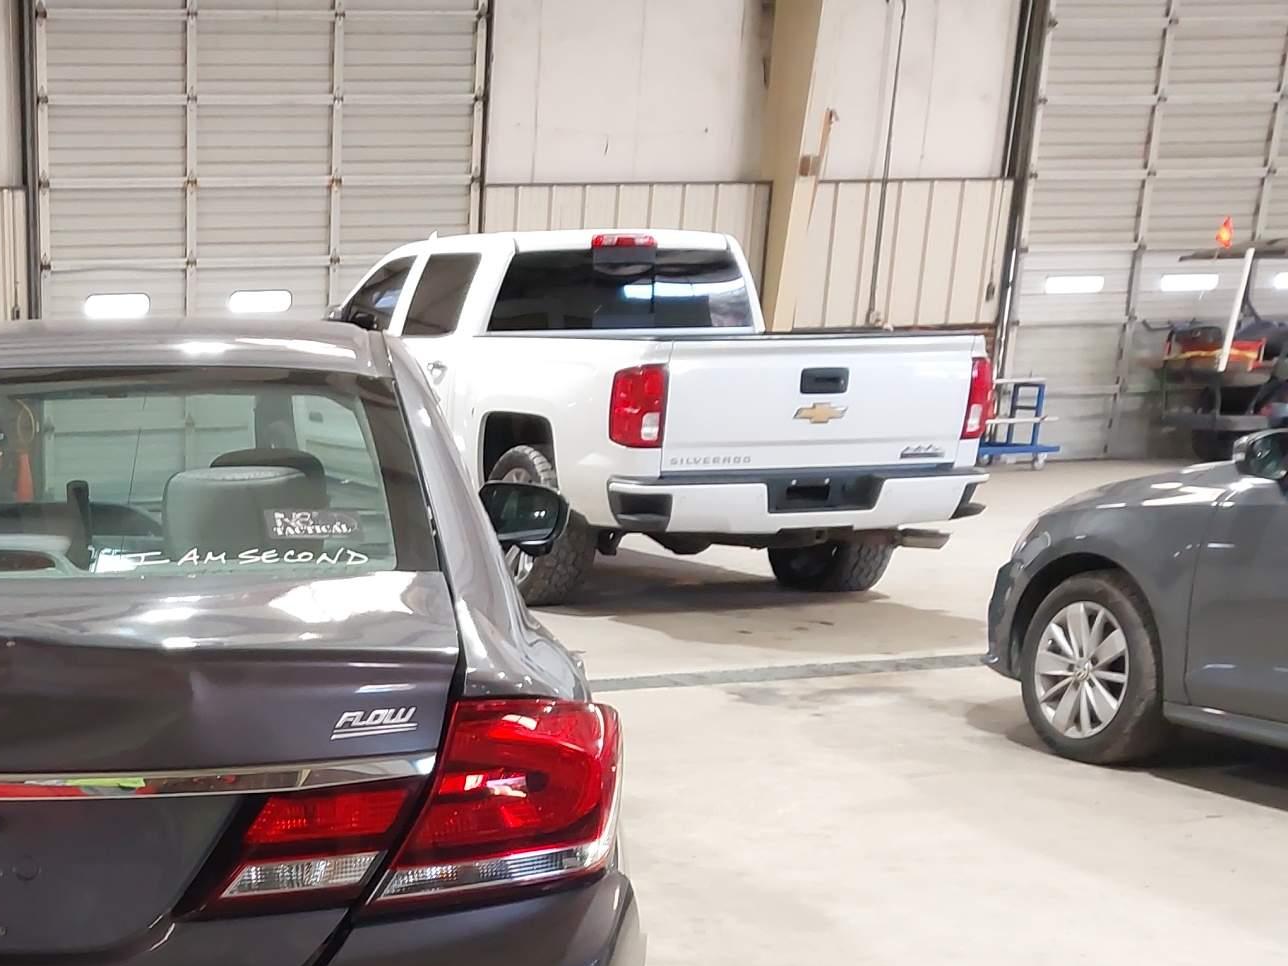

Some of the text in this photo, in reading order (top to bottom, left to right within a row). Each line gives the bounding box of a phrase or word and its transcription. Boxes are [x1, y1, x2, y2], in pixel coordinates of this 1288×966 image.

[669, 455, 752, 465] SILVERADO
[273, 522, 352, 536] TACTICAL
[177, 548, 226, 567] AM
[238, 547, 370, 566] SECOND
[334, 706, 417, 729] FLOW
